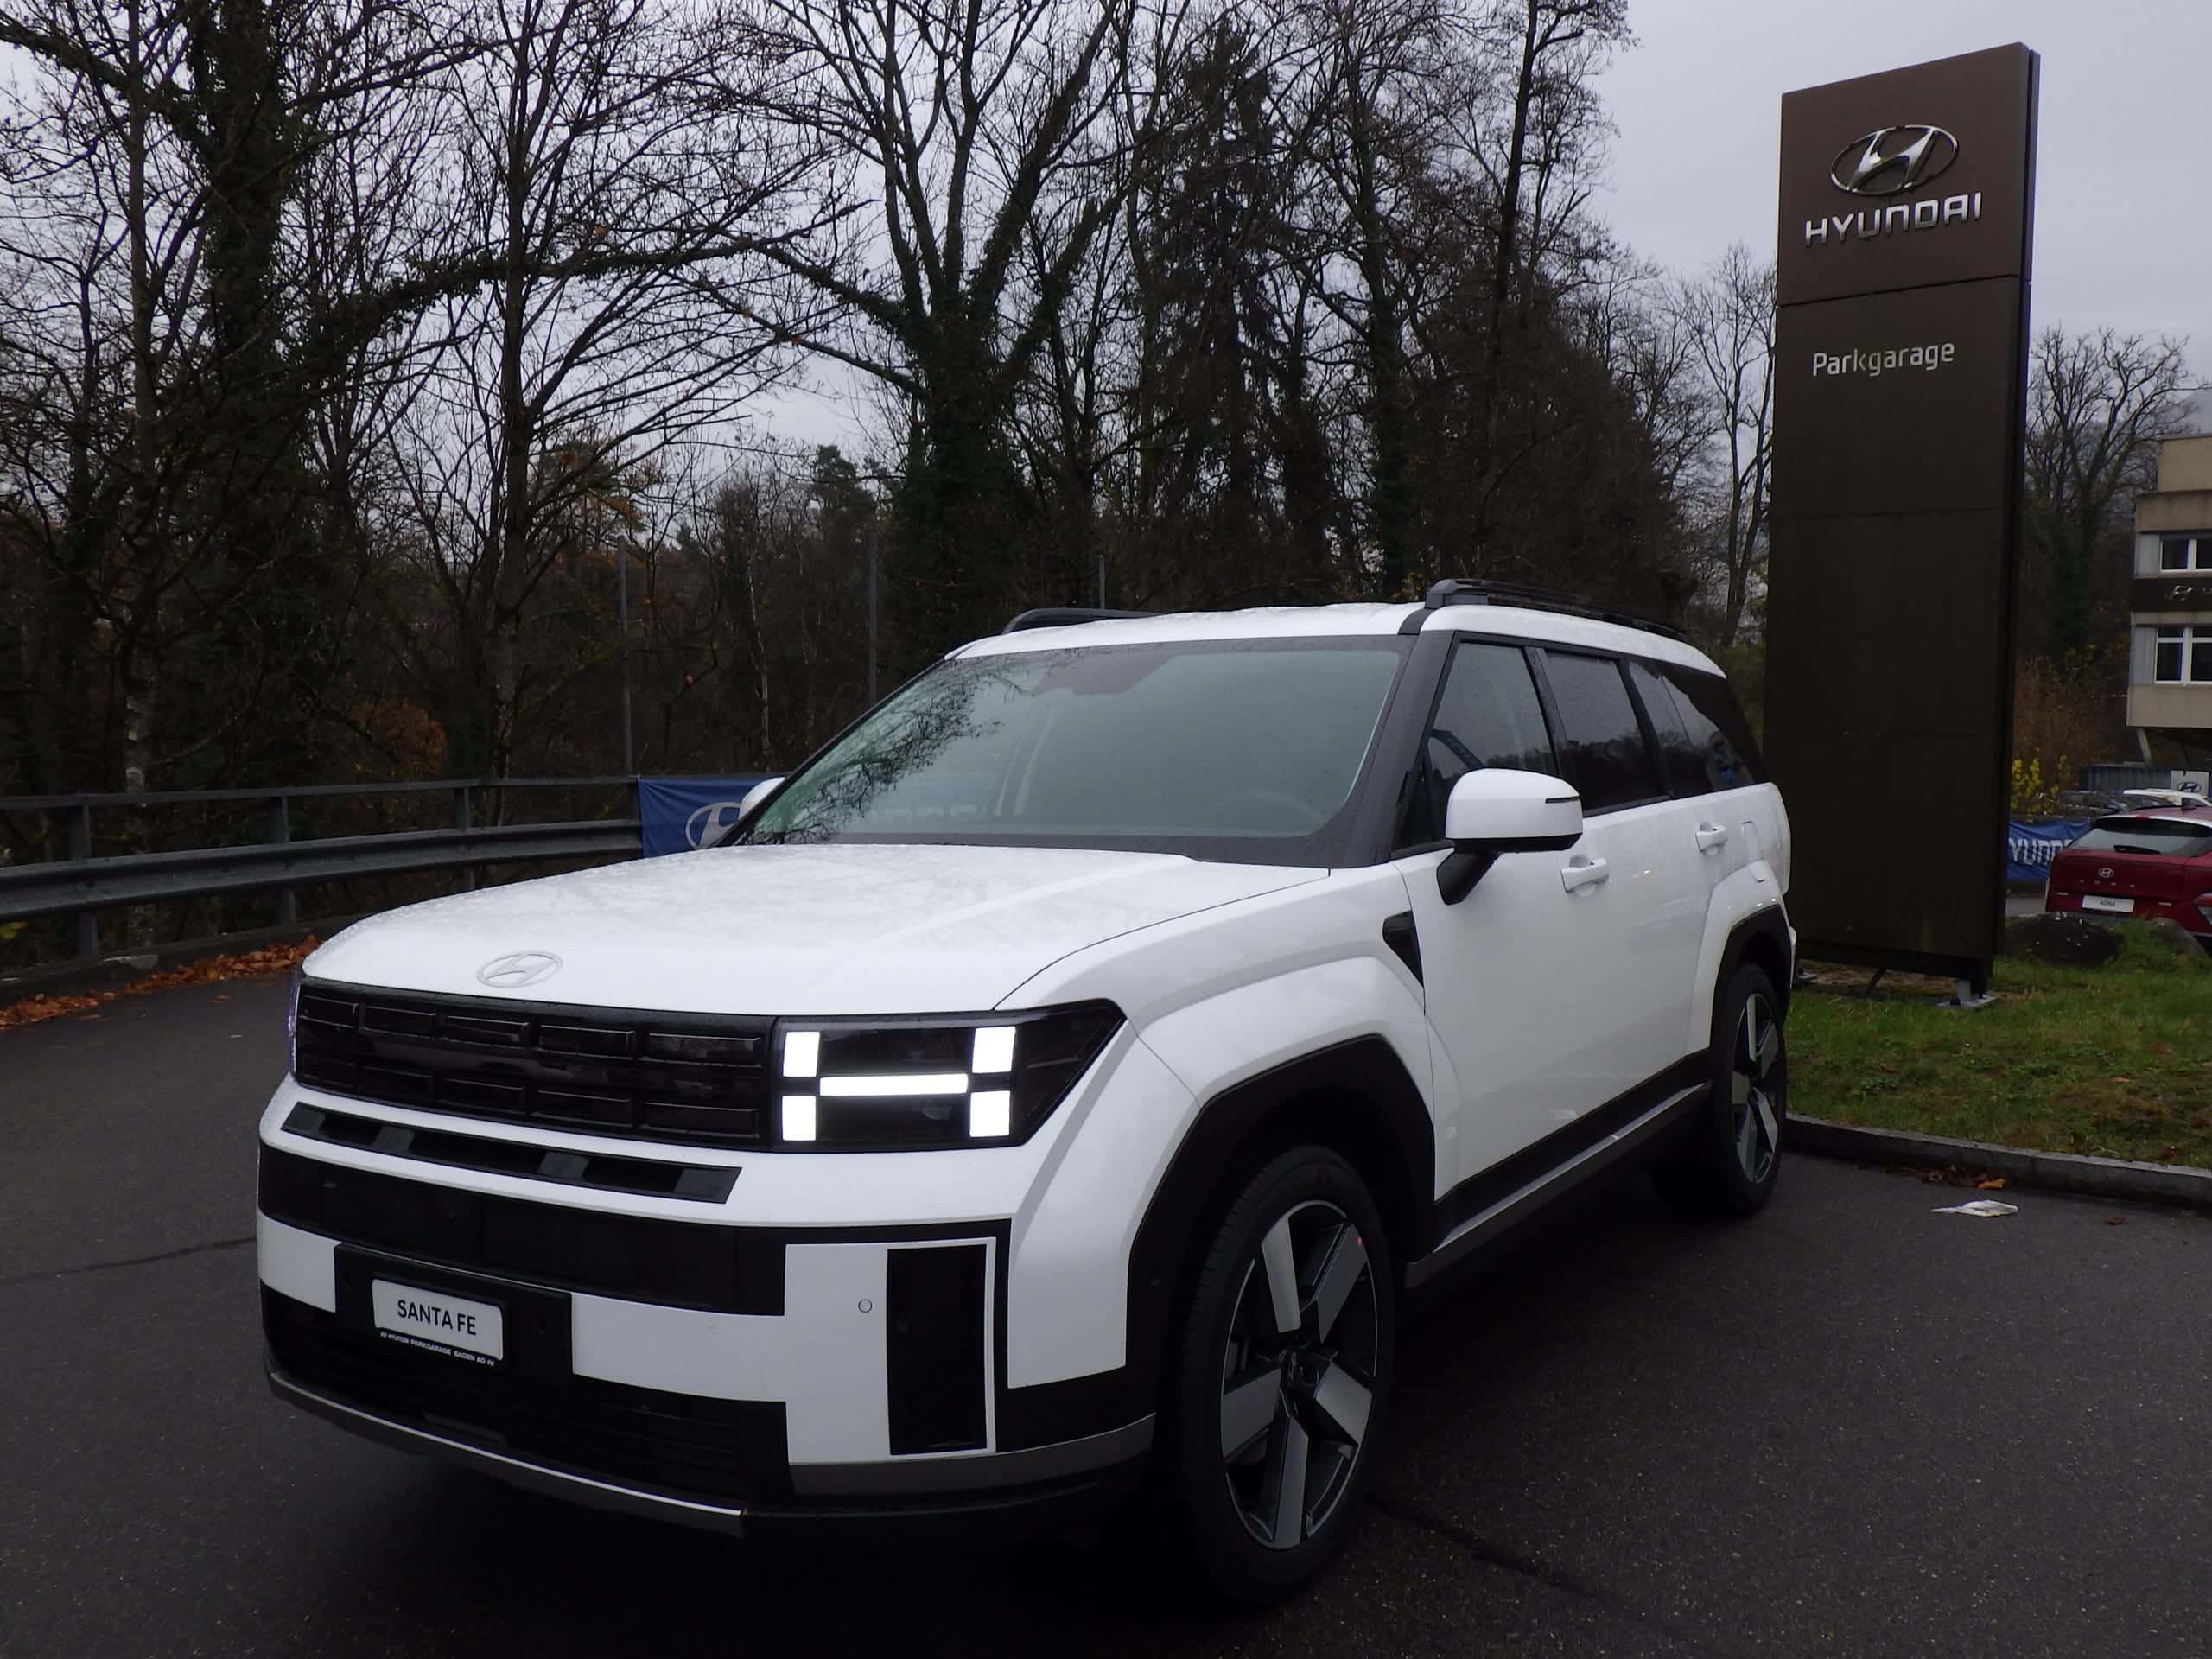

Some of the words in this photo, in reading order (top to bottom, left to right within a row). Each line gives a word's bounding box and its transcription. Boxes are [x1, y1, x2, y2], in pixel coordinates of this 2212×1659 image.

[1805, 192, 1982, 247] HYUNDAI
[1812, 342, 1955, 377] Parkgarage
[397, 1299, 453, 1329] SANTA
[457, 1313, 477, 1336] FE
